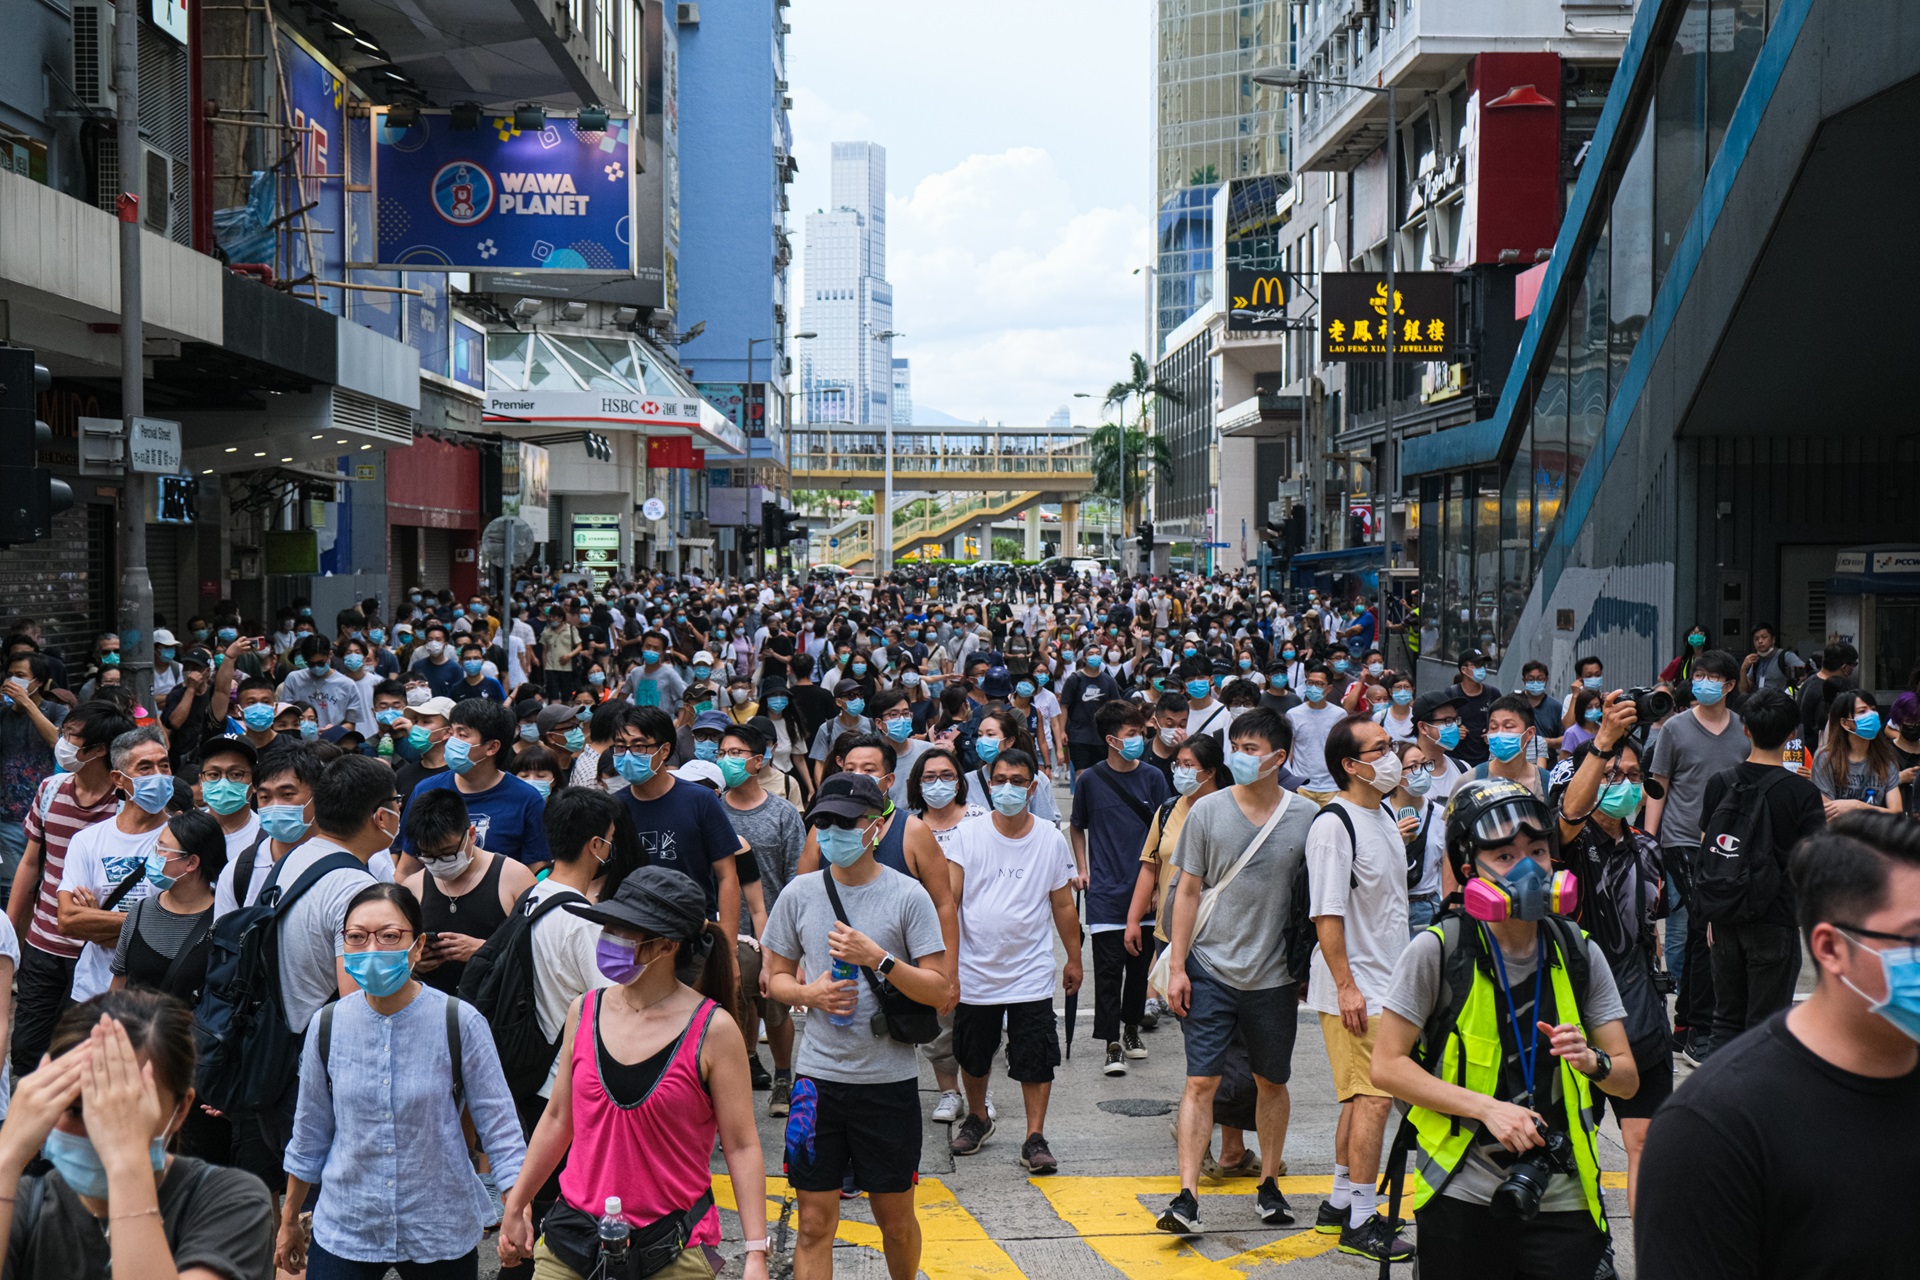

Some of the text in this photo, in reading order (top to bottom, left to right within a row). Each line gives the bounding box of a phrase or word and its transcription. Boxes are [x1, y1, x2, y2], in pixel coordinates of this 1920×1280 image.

[500, 172, 576, 194] WAWA
[1423, 154, 1460, 209] Pizza Hut
[500, 194, 590, 216] PLANET
[1329, 345, 1444, 353] LAO FENG XIAG JEWELLERY
[491, 398, 535, 411] Premier
[601, 398, 639, 414] HSBC
[141, 424, 171, 441] Percival Street
[1894, 558, 1920, 566] PCCW
[998, 868, 1024, 880] NYC
